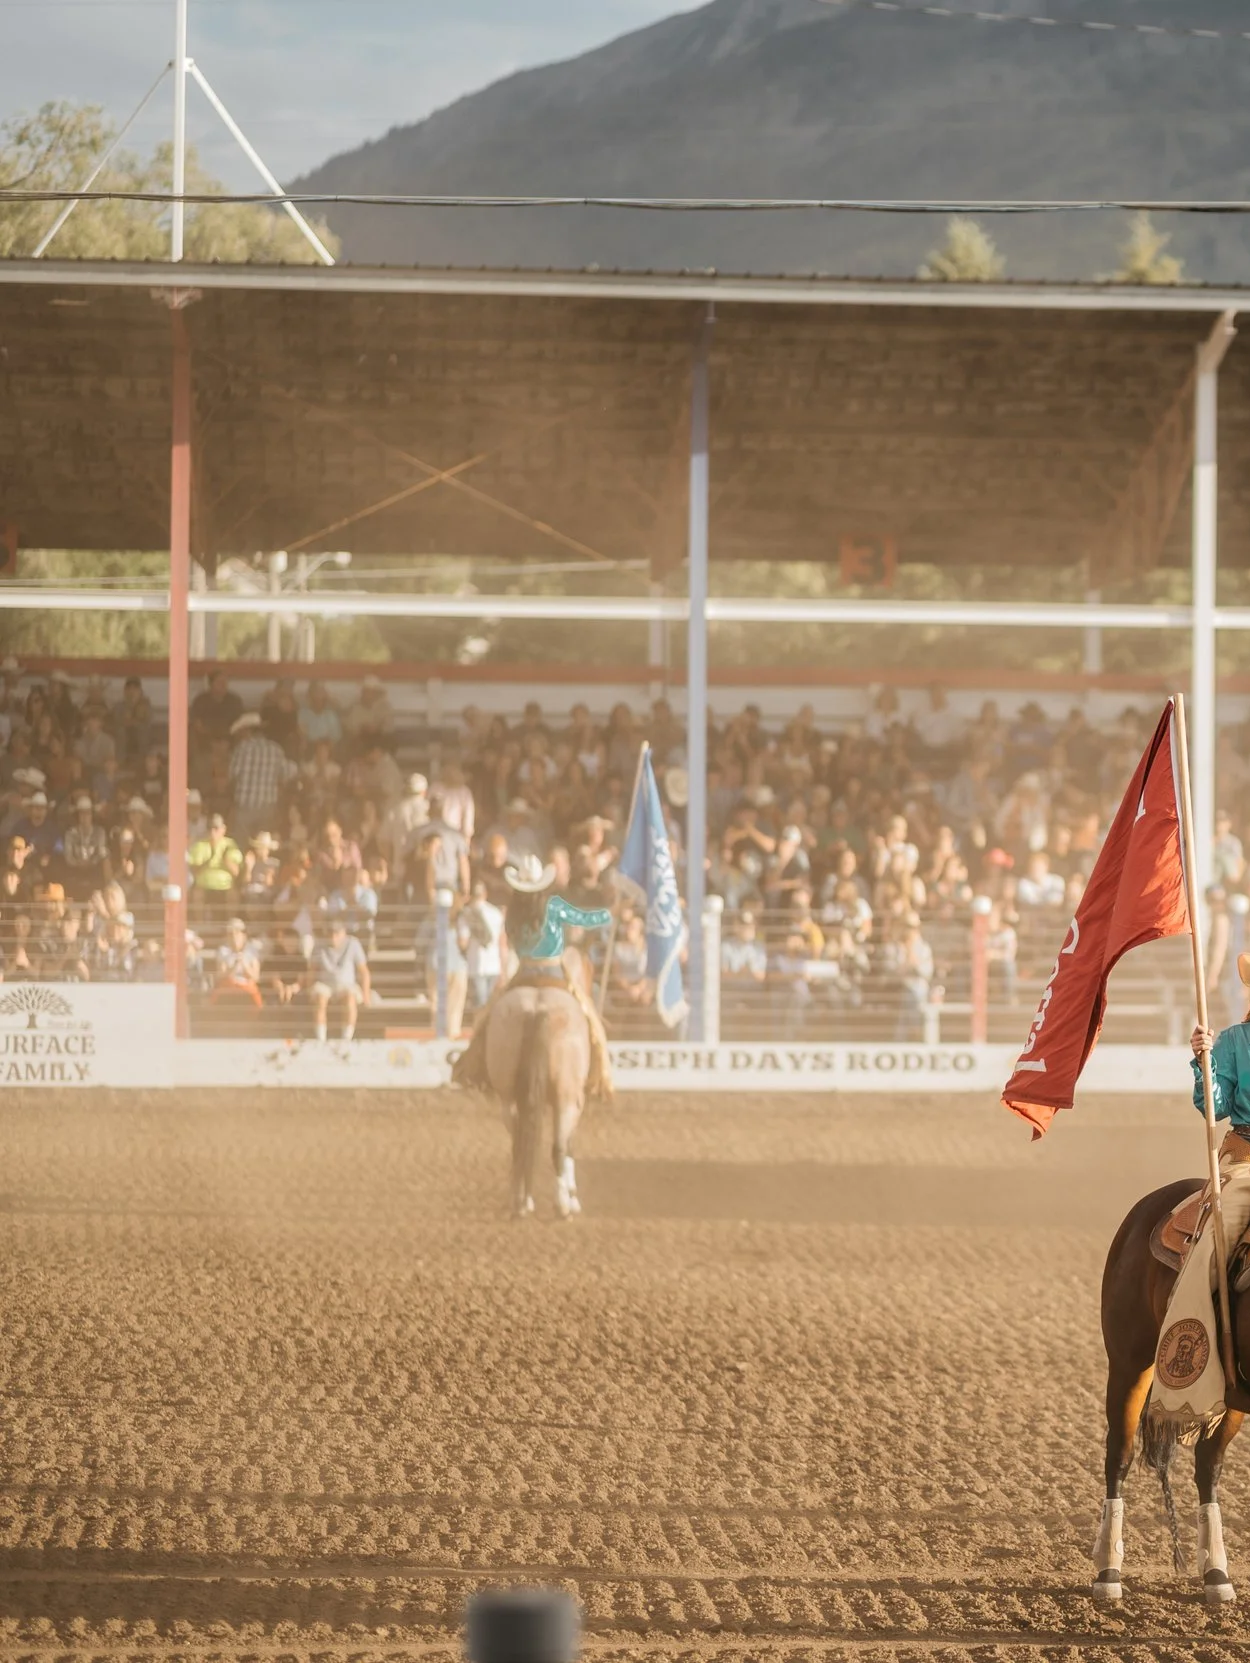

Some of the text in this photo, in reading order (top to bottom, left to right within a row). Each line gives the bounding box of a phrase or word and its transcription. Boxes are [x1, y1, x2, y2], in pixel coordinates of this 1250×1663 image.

[608, 1049, 977, 1072] SEPH DAYS RODEO
[1161, 1330, 1175, 1358] CHIEF
